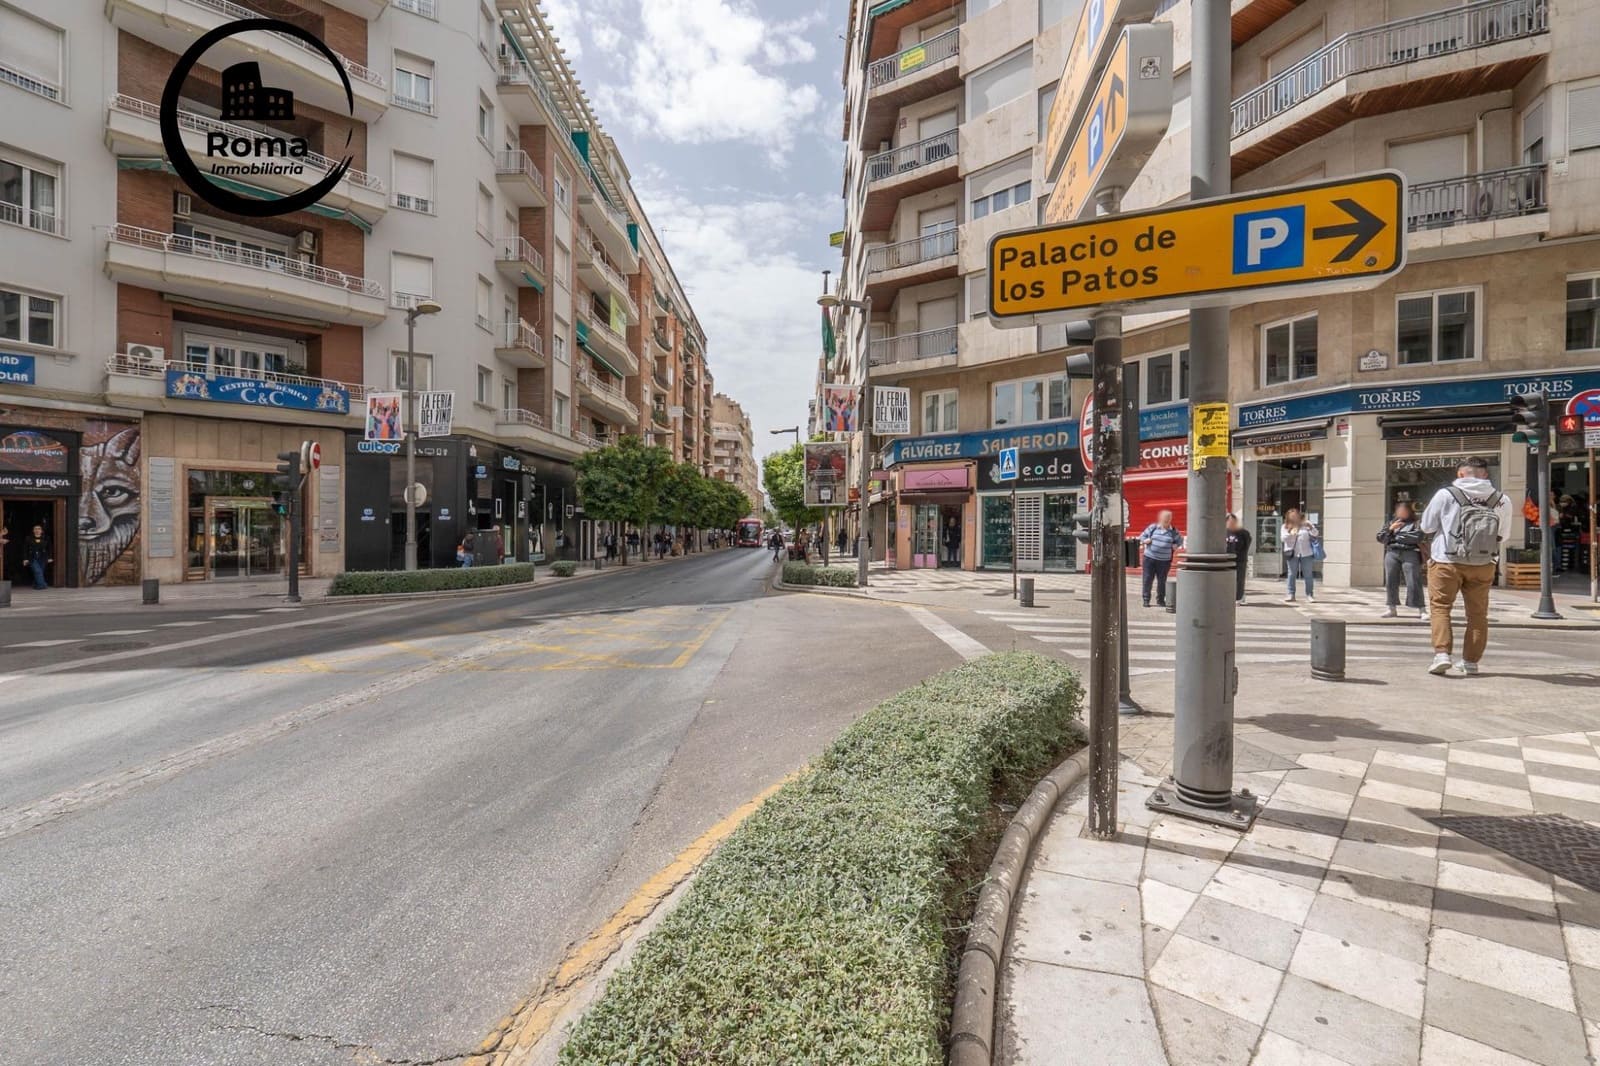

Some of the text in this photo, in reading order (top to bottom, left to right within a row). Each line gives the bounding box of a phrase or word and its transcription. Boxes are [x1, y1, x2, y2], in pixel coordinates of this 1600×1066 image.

[1090, 114, 1101, 166] P
[1000, 226, 1177, 271] Palacio de
[1247, 216, 1289, 266] P
[1000, 265, 1159, 302] los Patos
[0, 356, 19, 365] AD
[219, 381, 256, 393] CENTRO
[1504, 380, 1572, 397] TORRES
[240, 388, 285, 406] C&C
[422, 395, 430, 409] LA
[876, 391, 907, 407] LA FERIA
[1359, 390, 1421, 405] TORRES
[875, 407, 908, 422] DEL VINO
[1243, 406, 1287, 422] TORRES
[358, 440, 400, 453] wiber
[901, 442, 960, 459] ALVAREZ
[1140, 444, 1190, 460] CORNE
[35, 478, 70, 488] yugen
